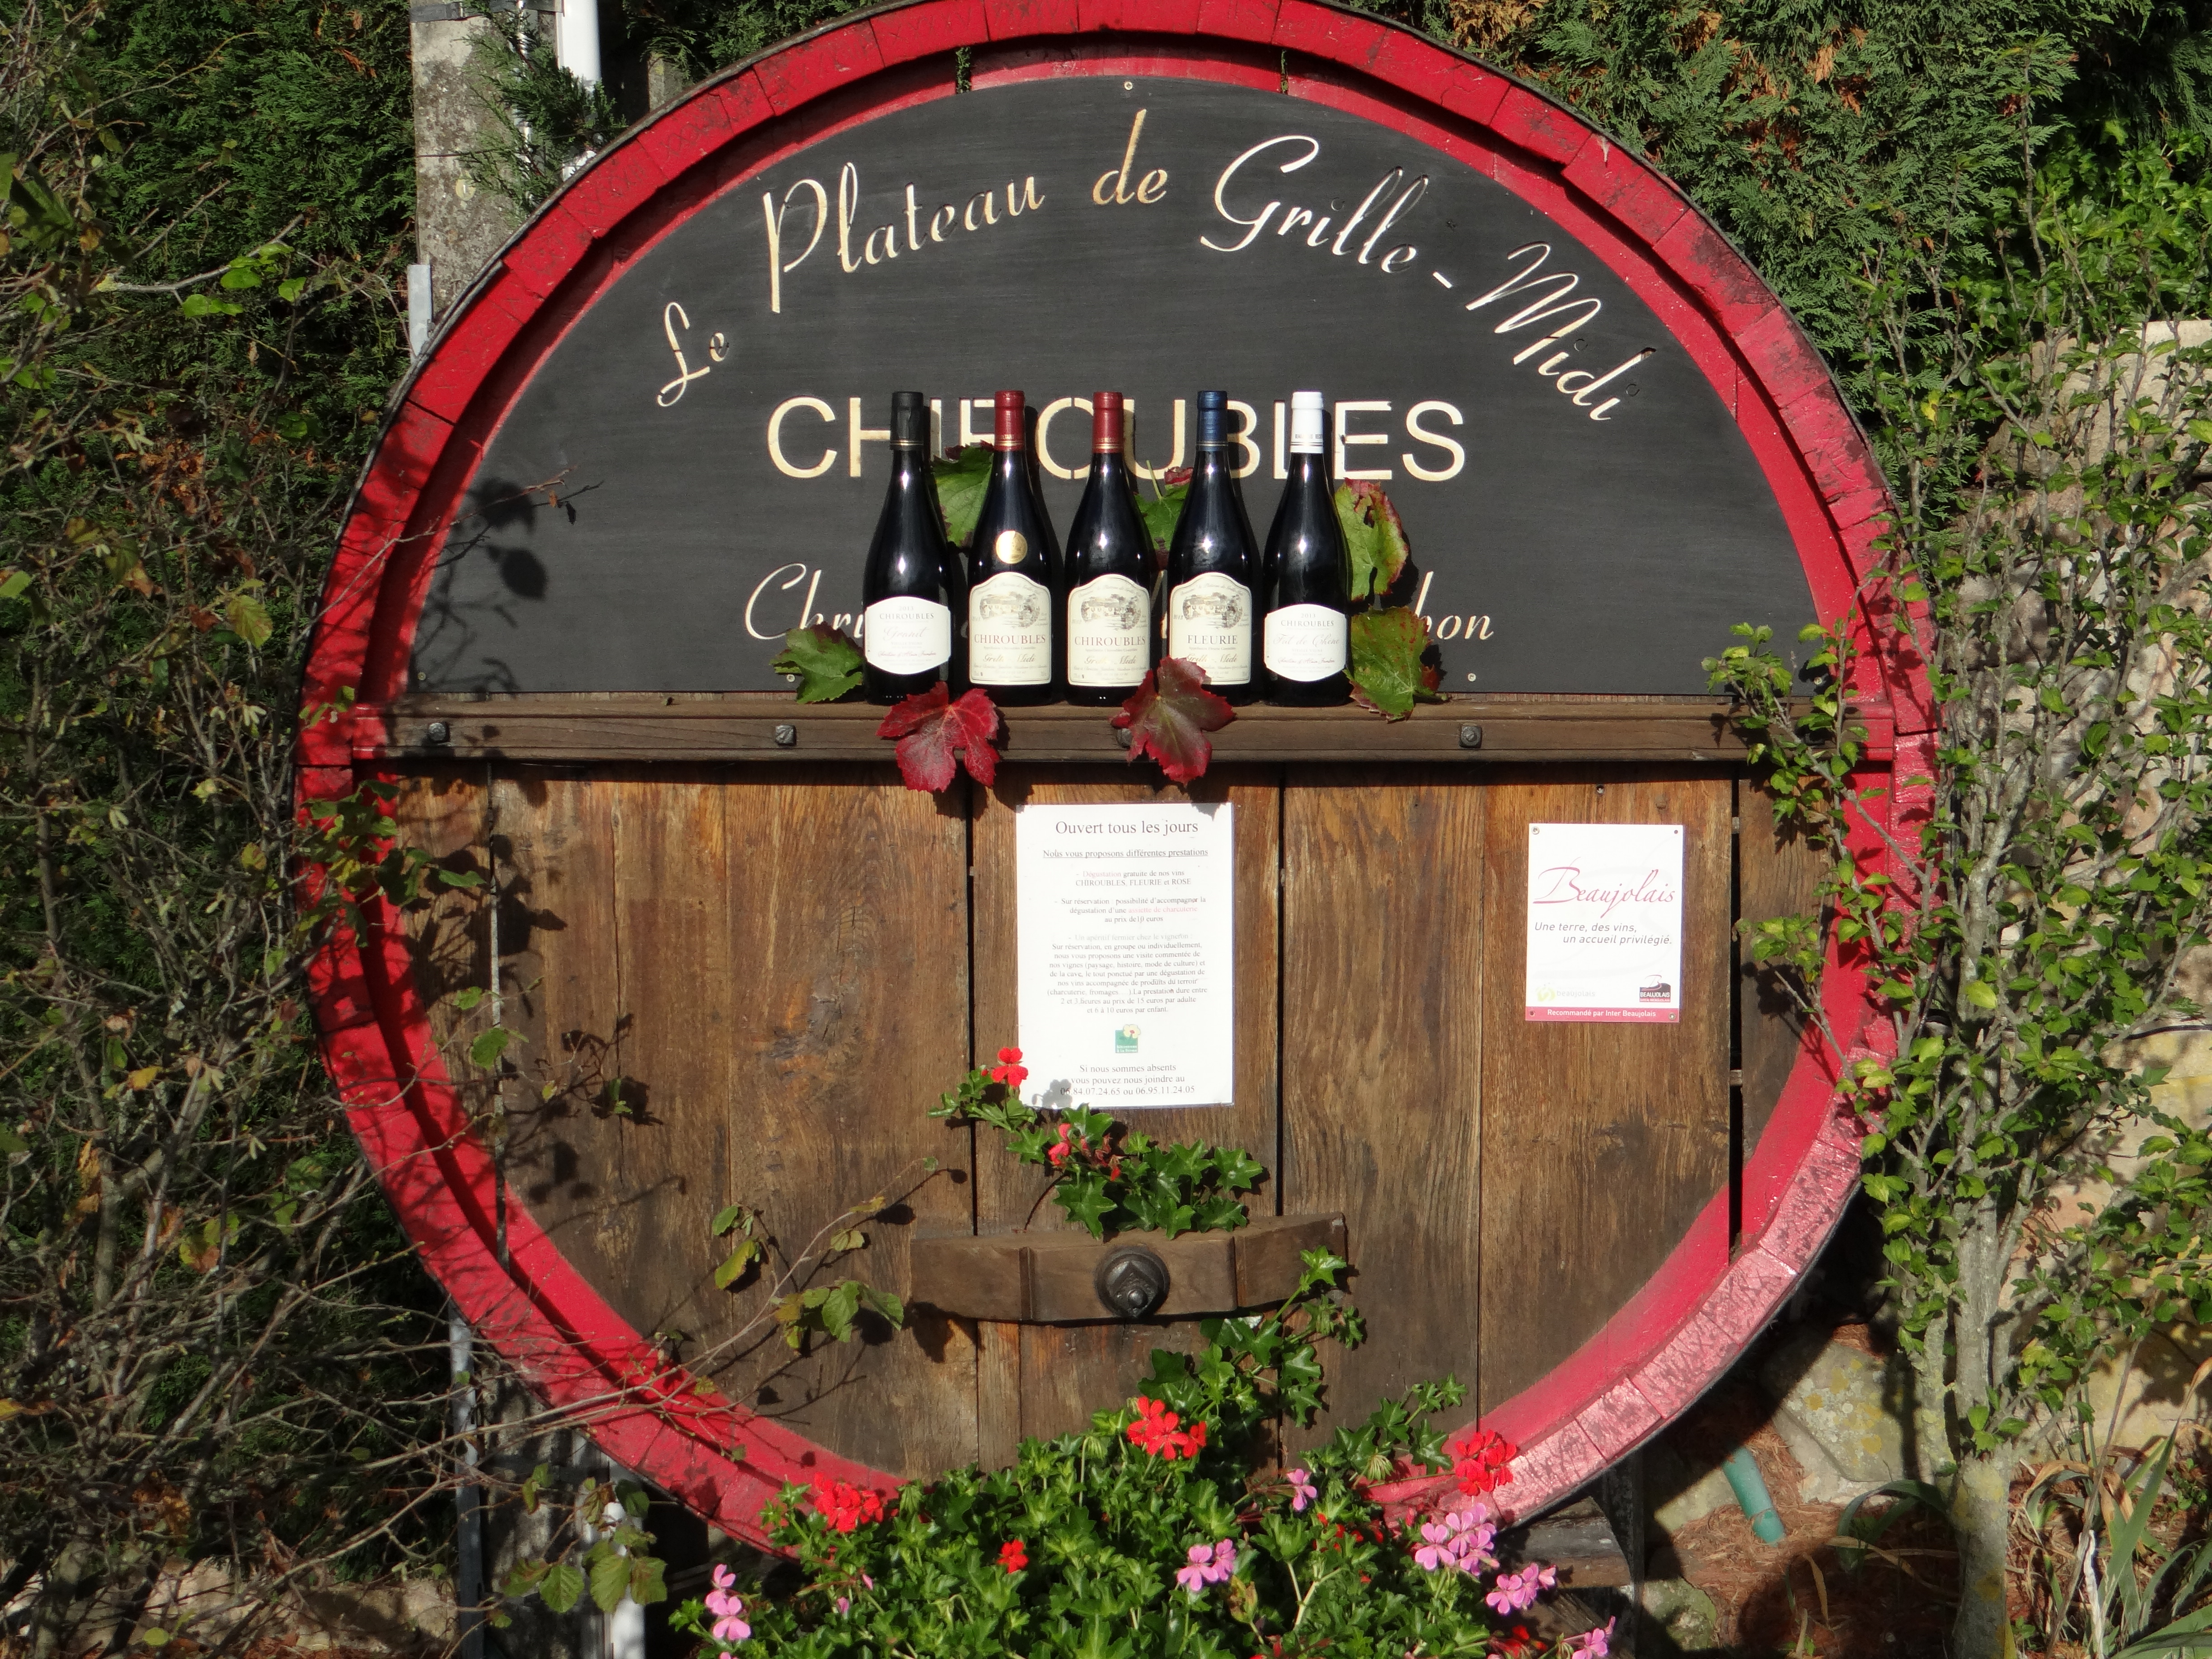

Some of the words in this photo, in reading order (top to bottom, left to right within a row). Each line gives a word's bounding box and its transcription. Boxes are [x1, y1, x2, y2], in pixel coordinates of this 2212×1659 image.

[657, 301, 730, 408] Le
[763, 161, 1045, 314] Plateau
[1092, 109, 1168, 206] de
[1200, 135, 1417, 273] Grille
[1465, 240, 1657, 421] Midi
[974, 634, 1046, 644] CHIROUBLES
[1074, 636, 1146, 646] CHIROUBLES
[1187, 635, 1238, 645] FLEURIE
[1055, 820, 1104, 834] Ouvert
[1107, 822, 1139, 834] tous
[1142, 821, 1160, 833] les
[1162, 820, 1199, 836] jours
[1043, 849, 1063, 858] Nous
[1085, 851, 1124, 859] proposons
[1126, 848, 1166, 857] différentes
[1168, 848, 1208, 858] prestations
[1532, 857, 1676, 919] Beaujolais
[1115, 897, 1148, 906] possibilité
[1150, 897, 1199, 905] d'accompagner
[1069, 906, 1106, 916] dégustation
[1114, 916, 1127, 924] prix
[1534, 922, 1555, 931] Une
[1558, 923, 1588, 933] terre,
[1591, 923, 1610, 932] des
[1613, 923, 1637, 933] vins,
[1563, 936, 1576, 944] un
[1579, 935, 1617, 944] accueil
[1619, 935, 1673, 946] privilégié.
[1159, 969, 1196, 978] dégustation
[1086, 979, 1129, 988] accompagnée
[1140, 979, 1167, 987] produits
[1143, 987, 1174, 996] prestation
[1622, 1009, 1656, 1018] Beaujolais
[1079, 1064, 1088, 1073] Si
[1147, 1063, 1176, 1072] absents
[1092, 1078, 1122, 1086] pouvez
[1143, 1074, 1173, 1085] joindre
